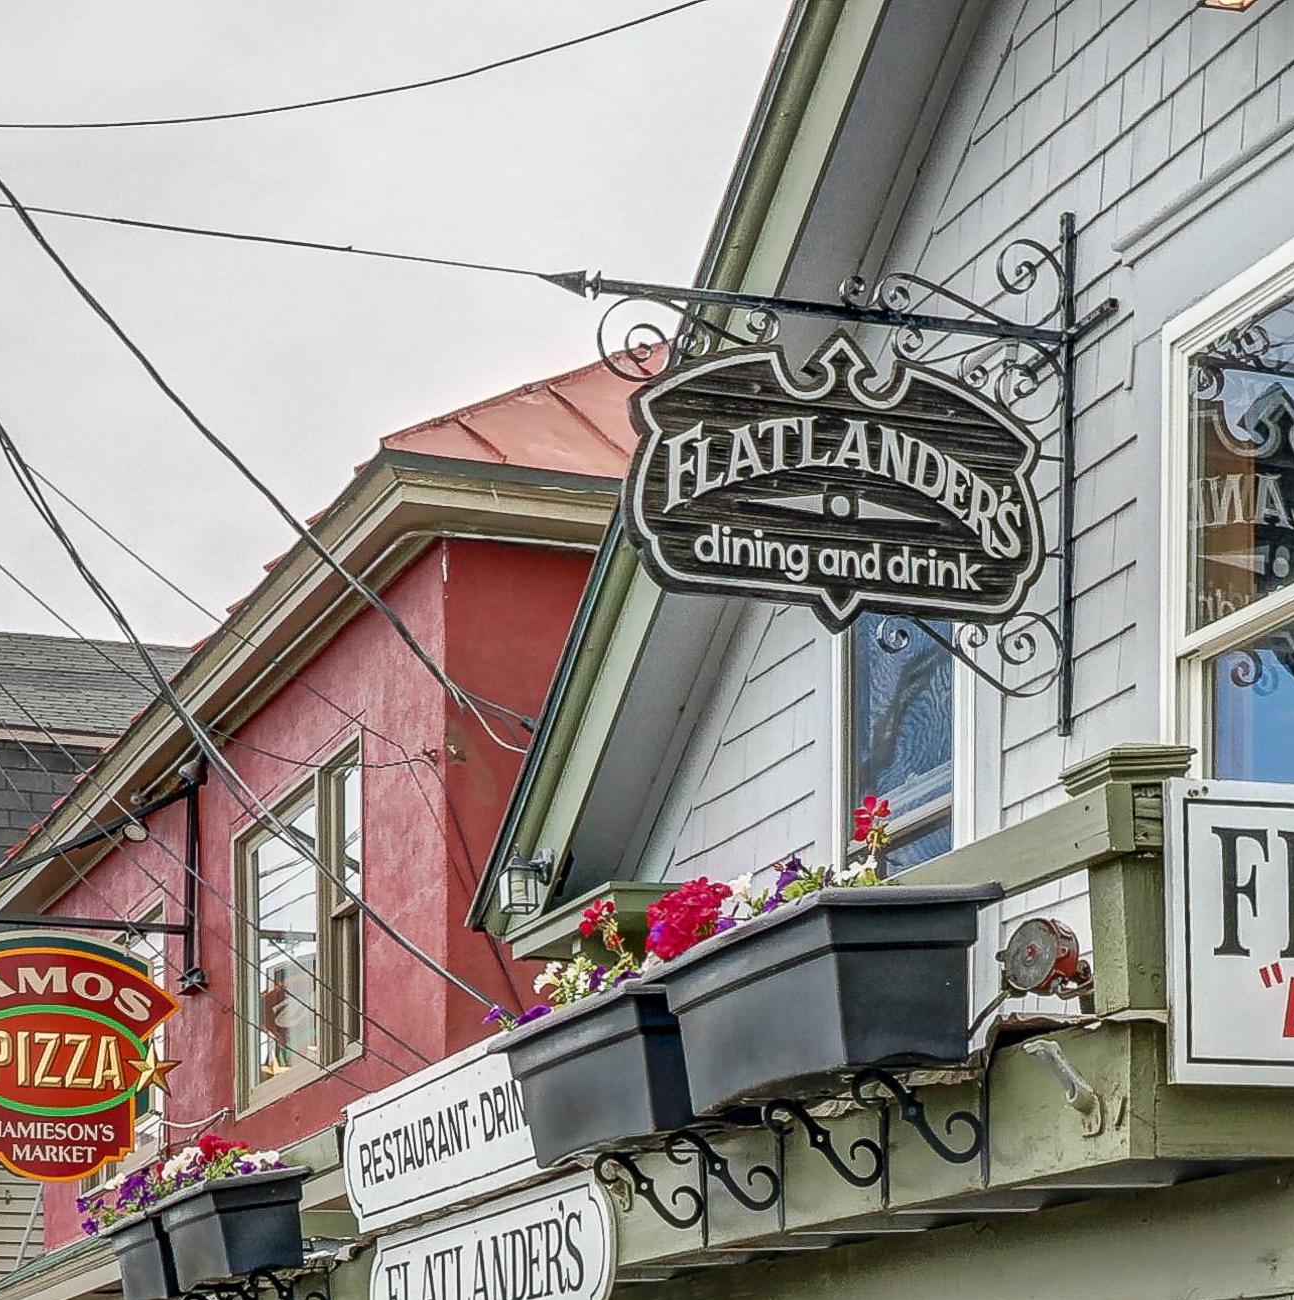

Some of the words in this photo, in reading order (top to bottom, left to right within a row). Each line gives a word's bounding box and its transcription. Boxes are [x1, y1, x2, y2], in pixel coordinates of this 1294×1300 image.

[663, 415, 1023, 560] FLATLANDER'S
[694, 524, 809, 582] dining
[818, 544, 882, 582] and
[888, 547, 984, 592] drink
[12, 1146, 97, 1164] MARKET
[358, 1099, 470, 1188] RESTAURANT
[479, 1078, 527, 1143] DRIN
